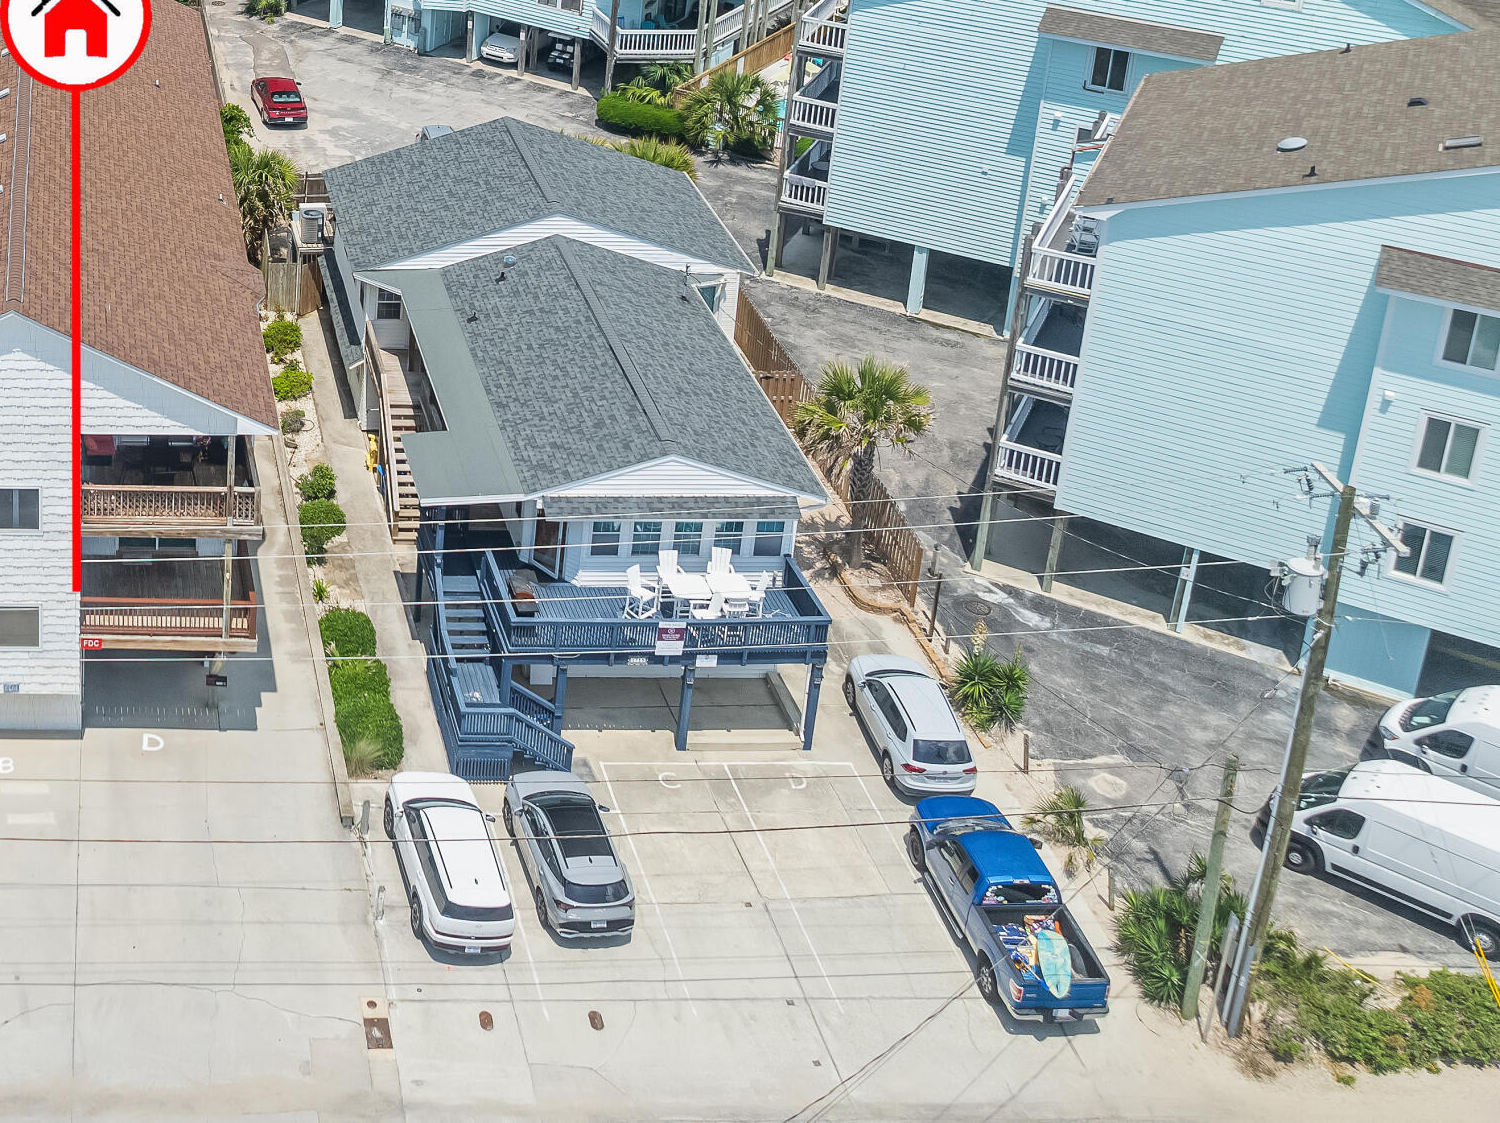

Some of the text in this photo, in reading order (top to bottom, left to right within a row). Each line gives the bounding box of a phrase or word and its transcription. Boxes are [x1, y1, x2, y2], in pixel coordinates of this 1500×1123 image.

[83, 639, 100, 647] FDC
[142, 732, 165, 751] D
[0, 756, 15, 774] B
[658, 772, 682, 789] C
[785, 772, 807, 789] D
